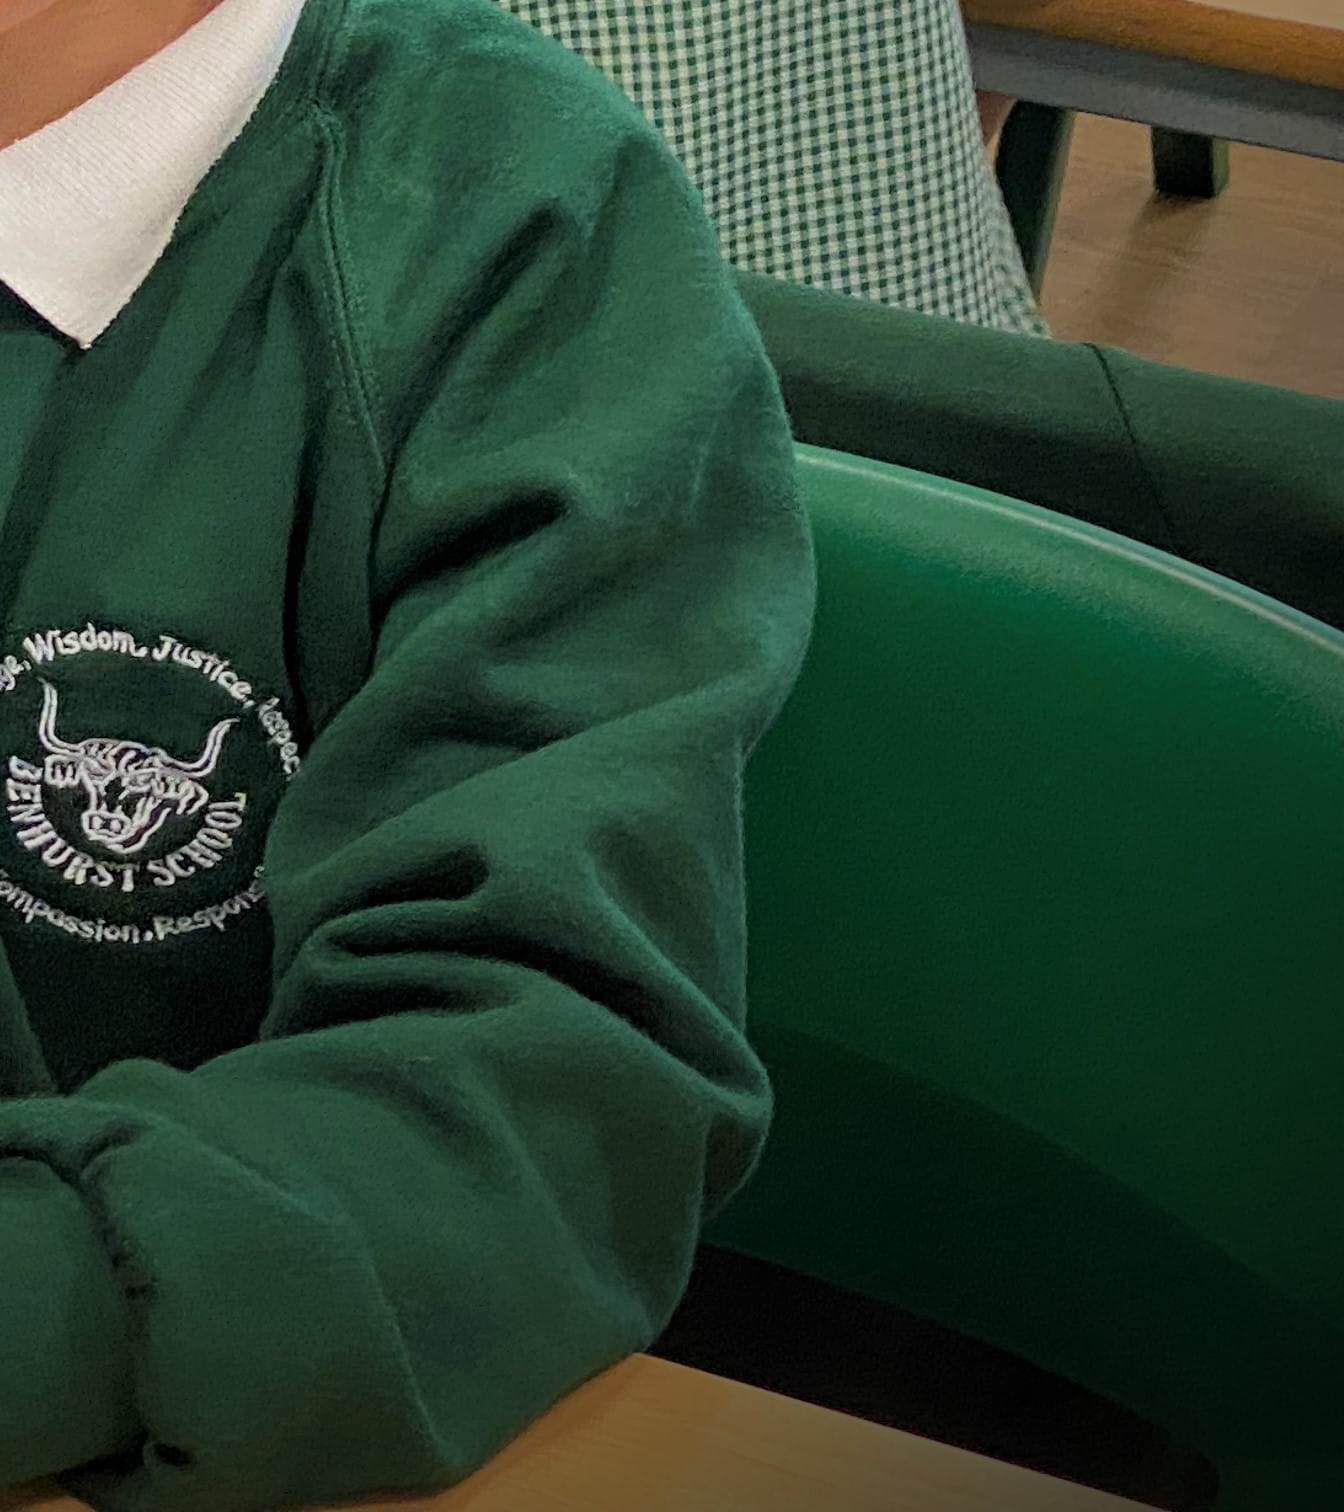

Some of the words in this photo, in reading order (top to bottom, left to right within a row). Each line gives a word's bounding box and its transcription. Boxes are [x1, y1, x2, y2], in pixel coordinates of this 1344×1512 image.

[152, 634, 256, 709] Justice,
[5, 754, 141, 893] BENHURST
[145, 791, 248, 887] SCHOOL
